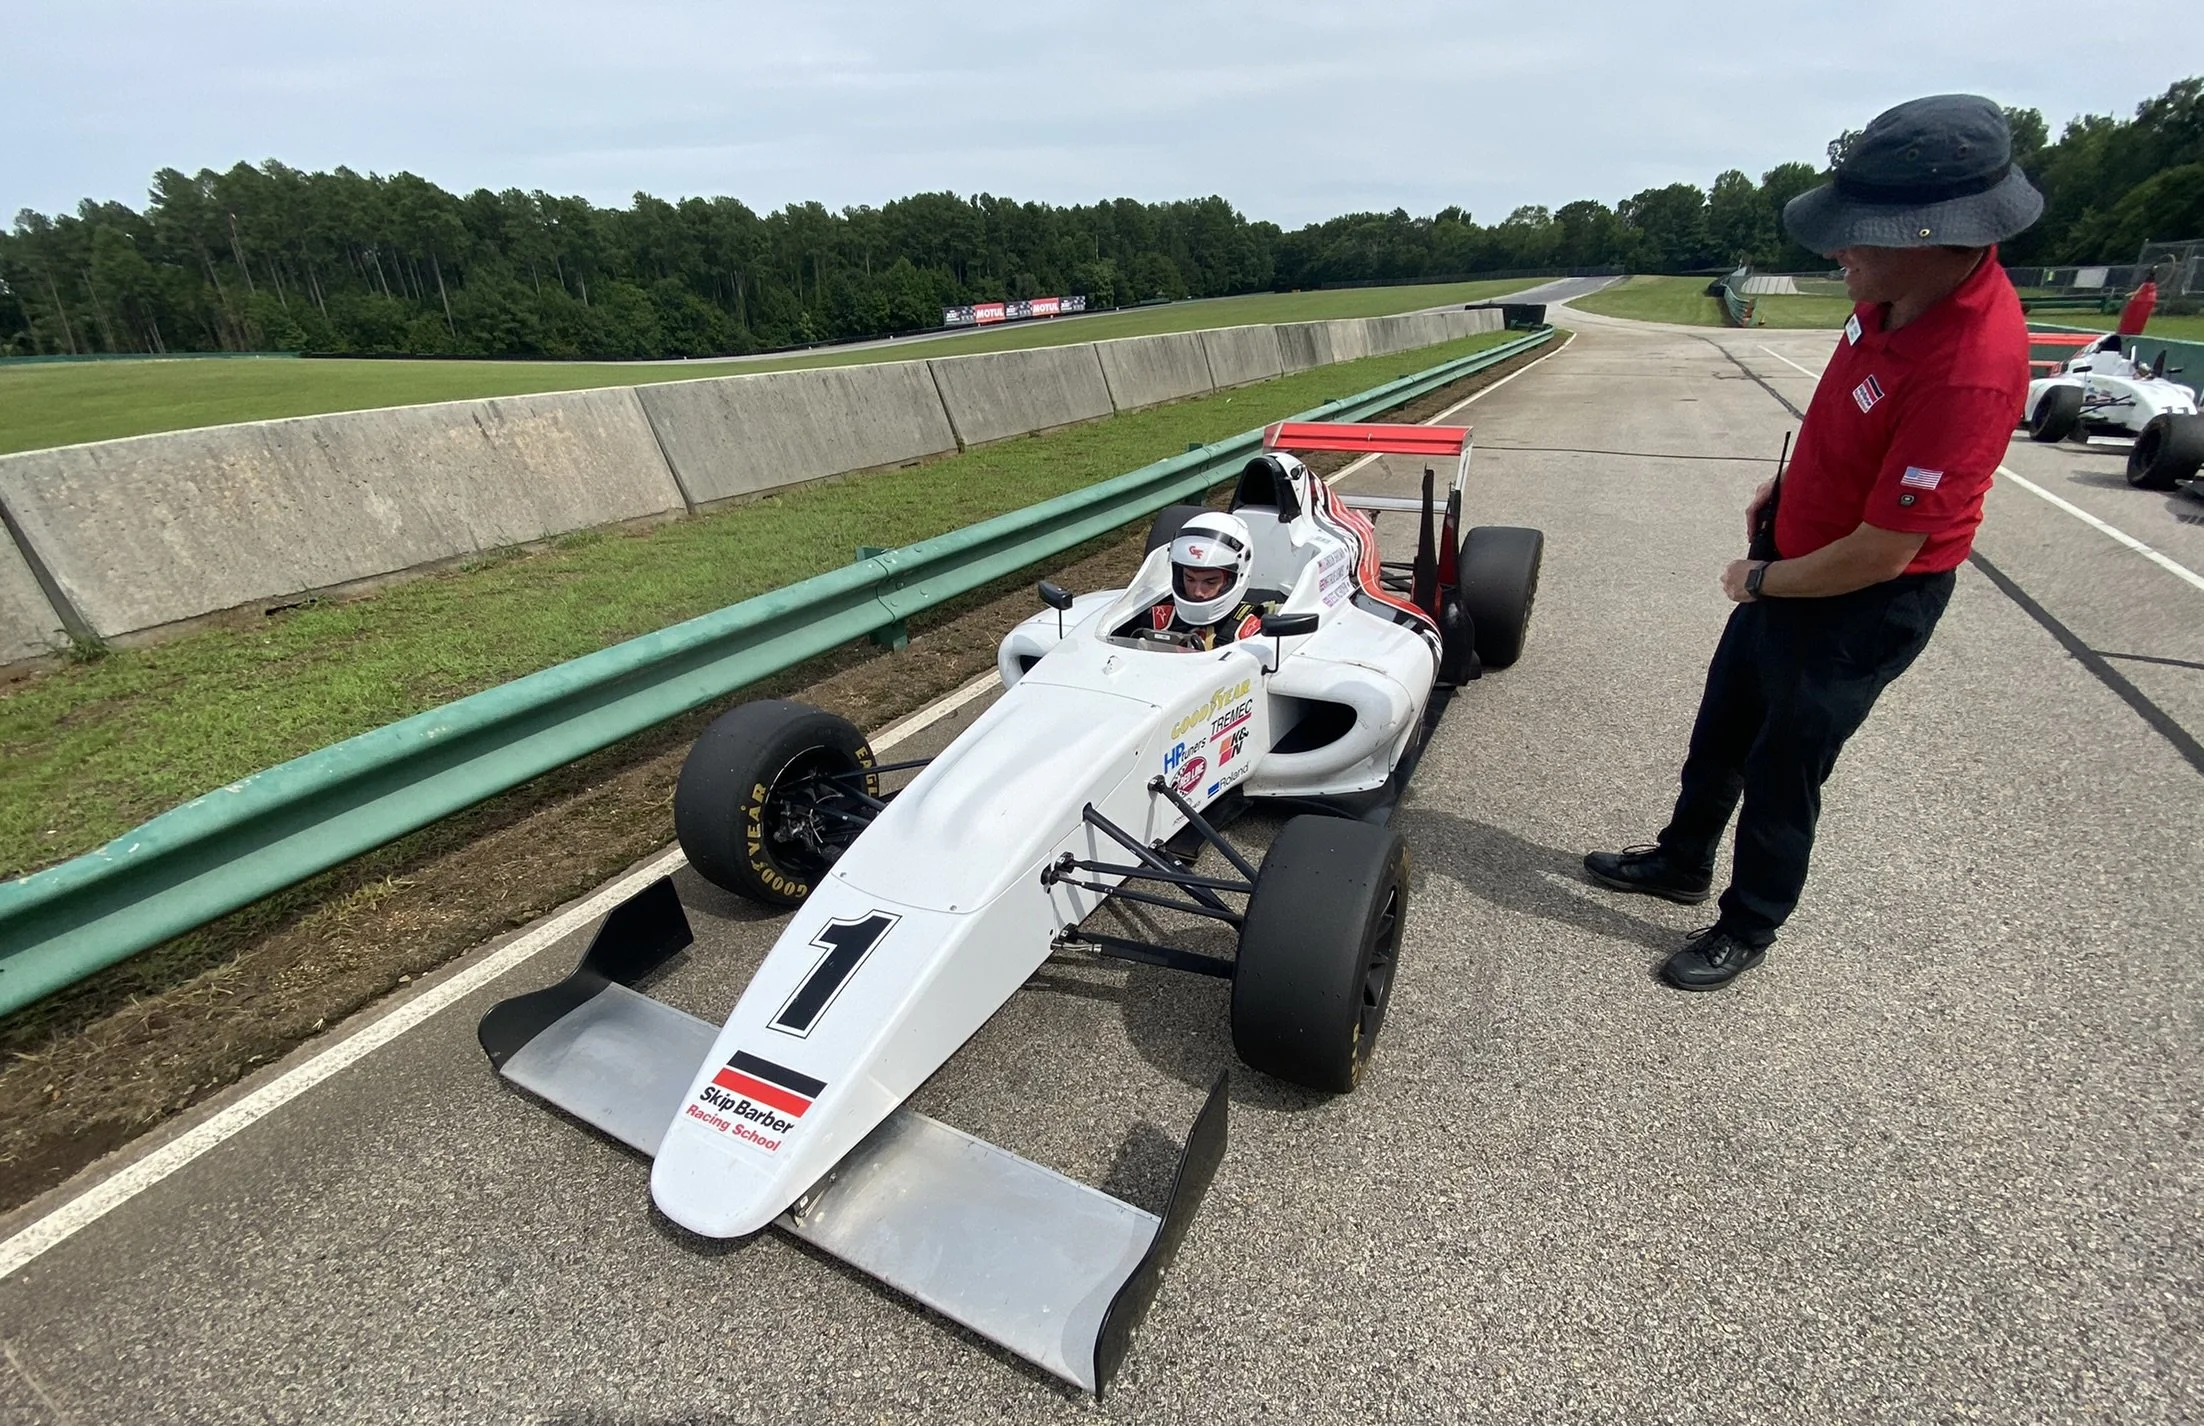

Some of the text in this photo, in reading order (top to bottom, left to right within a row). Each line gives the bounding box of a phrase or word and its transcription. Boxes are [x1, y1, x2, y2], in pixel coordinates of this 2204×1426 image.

[976, 307, 1005, 319] MOTUL
[1033, 302, 1059, 313] MOTUL
[1210, 699, 1253, 736] TREMEC
[855, 746, 878, 797] EAGL
[1220, 761, 1249, 790] Roland
[766, 909, 903, 1039] 1
[685, 1103, 782, 1152] Racing School
[699, 1086, 795, 1135] Skip Barber
